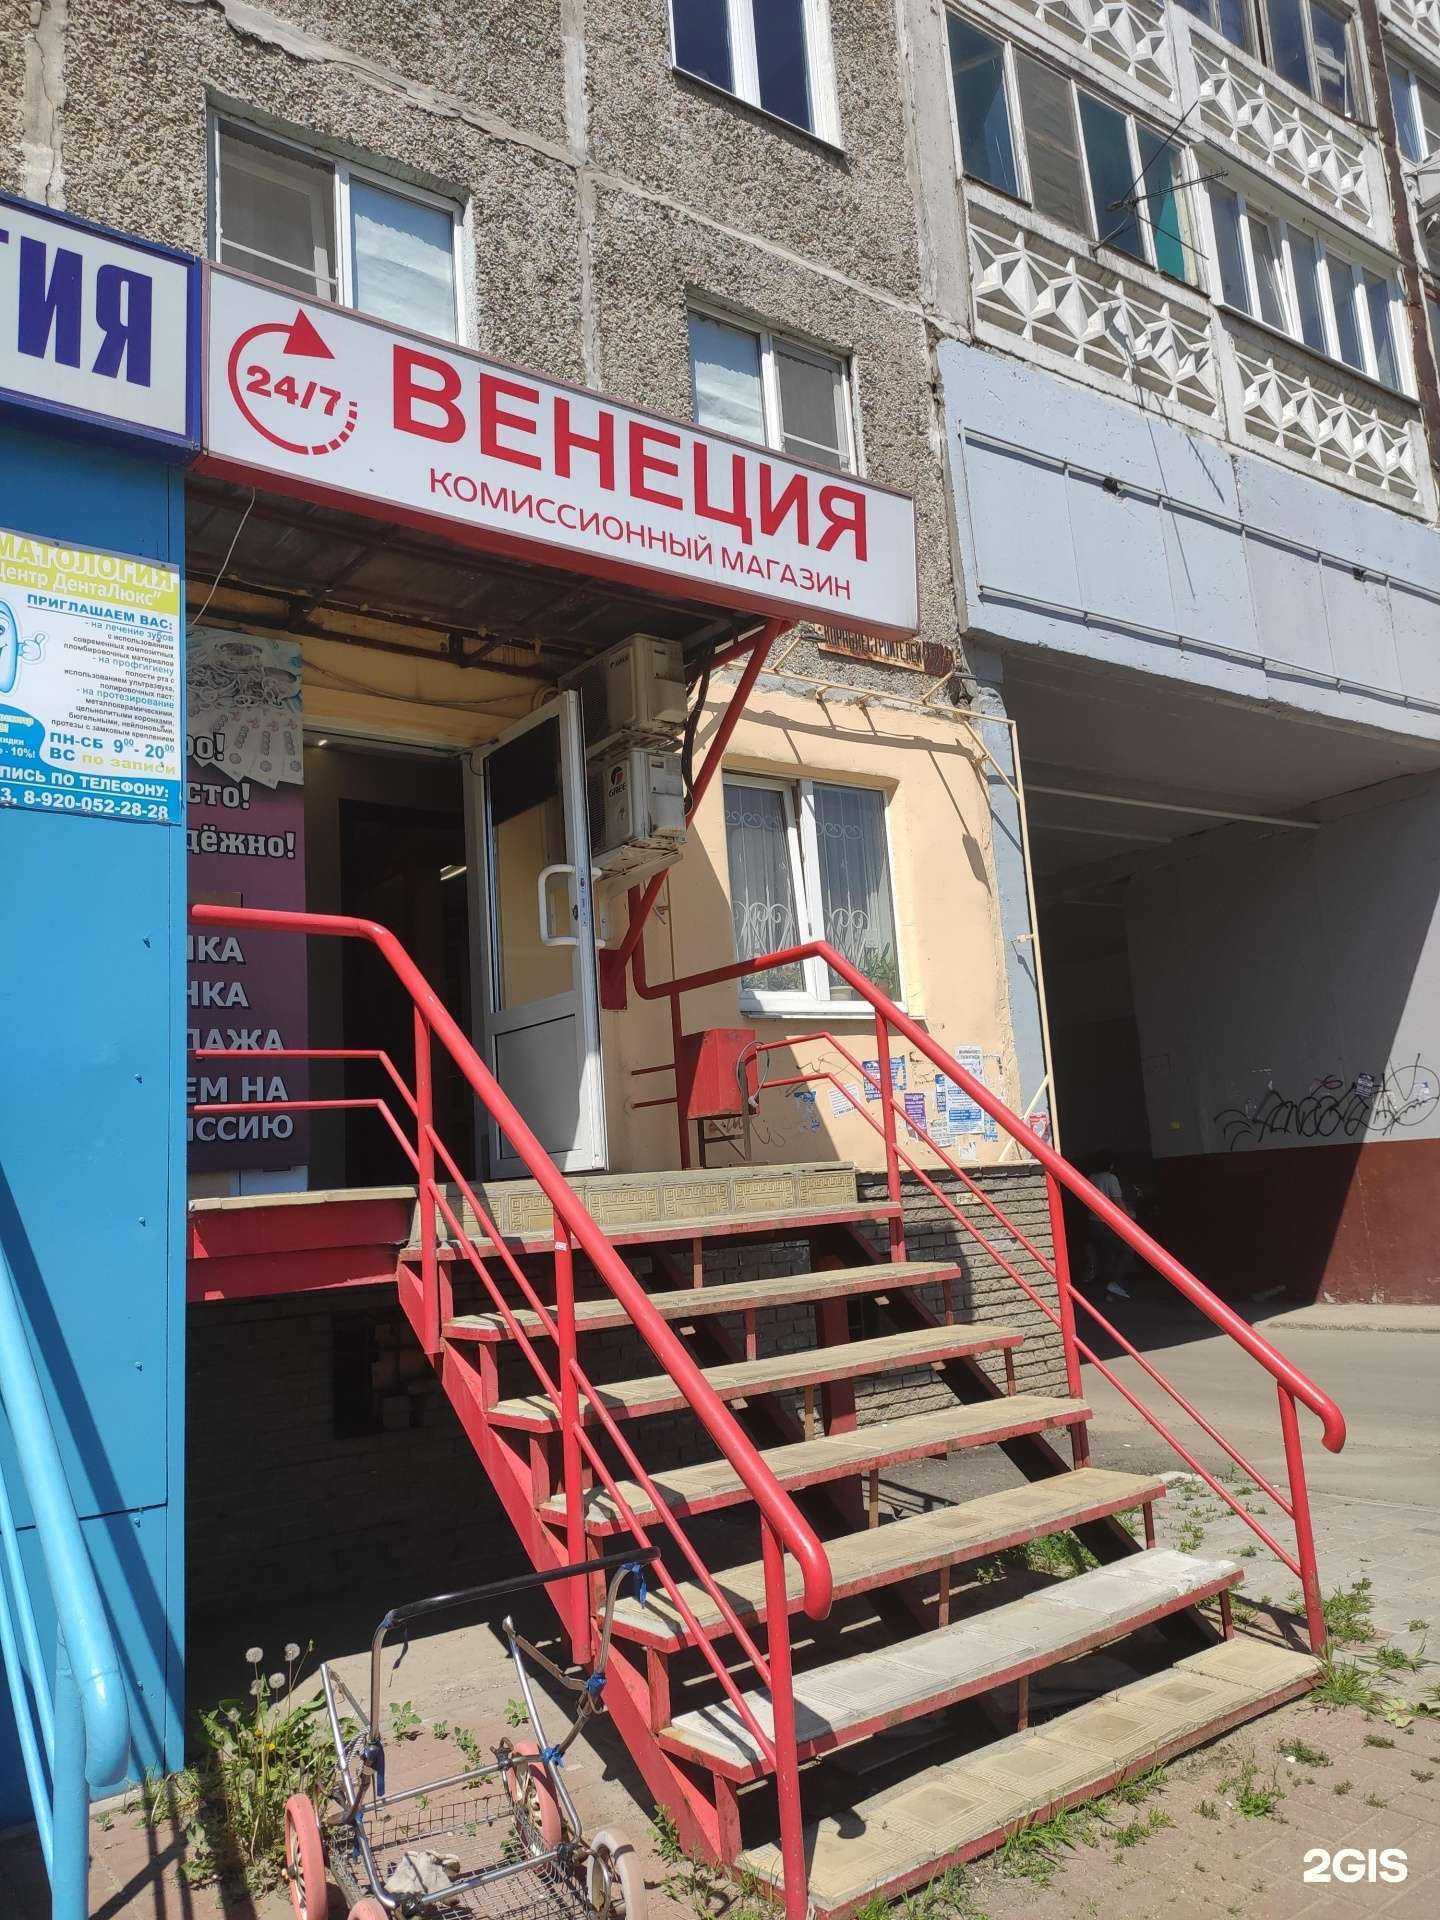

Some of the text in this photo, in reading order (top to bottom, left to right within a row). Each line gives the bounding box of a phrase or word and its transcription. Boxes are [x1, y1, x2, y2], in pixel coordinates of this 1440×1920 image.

[0, 229, 153, 388] ИЯ
[245, 364, 343, 417] 24/7
[392, 344, 869, 562] ВЕНЕЦИЯ
[429, 467, 852, 601] КОМИССИОННЫЙ МАГАЗИН
[27, 594, 173, 630] ПРИГЛАШАЕМ ВАС:
[91, 621, 102, 629] на
[105, 623, 144, 637] лечение
[147, 630, 174, 642] зубов
[113, 634, 174, 650] использованием
[63, 642, 129, 660] пломбировочных
[73, 636, 174, 659] современных композитных
[64, 668, 127, 684] использованием
[98, 656, 110, 664] на
[113, 658, 174, 677] профгигиену
[125, 670, 155, 680] полости
[82, 687, 94, 696] на
[97, 689, 174, 709] протезирование
[100, 683, 154, 698] полировочных
[50, 732, 103, 749] ПН-СБ
[51, 719, 84, 730] протезы
[92, 724, 130, 737] замковым
[132, 731, 174, 743] креплением
[50, 747, 176, 775] ВС по записи
[52, 772, 75, 786] ПО
[80, 776, 169, 798] ТЕЛЕФОНУ:
[608, 783, 626, 798] GREE
[24, 791, 169, 820] 8-920-052-28-28
[241, 1076, 289, 1102] НА
